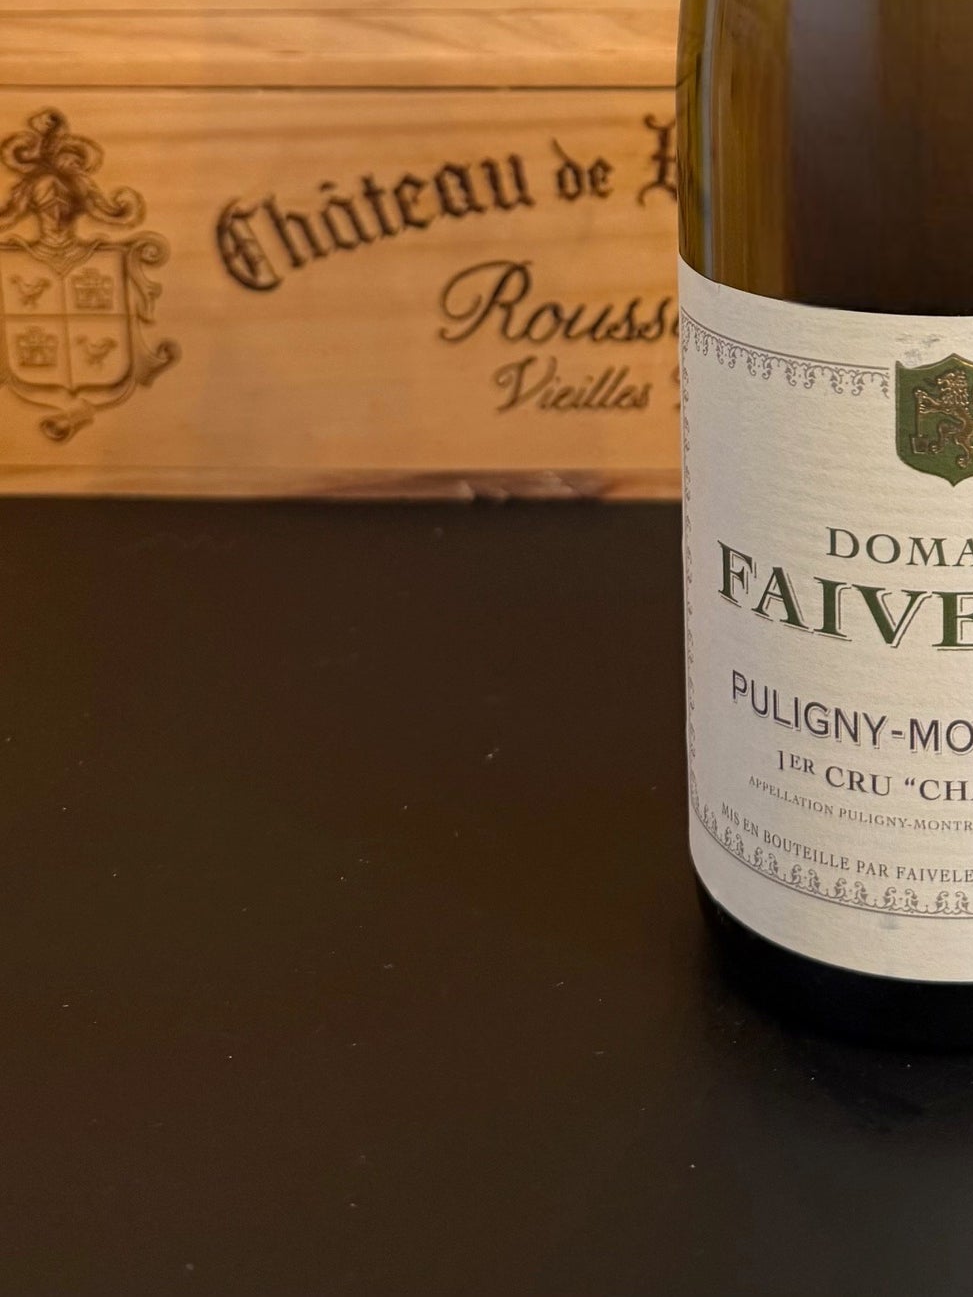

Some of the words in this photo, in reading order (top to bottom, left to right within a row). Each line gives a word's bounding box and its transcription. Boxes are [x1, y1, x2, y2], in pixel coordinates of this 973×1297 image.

[215, 153, 534, 291] Château
[552, 138, 613, 200] de
[438, 258, 679, 342] Rouss
[493, 355, 653, 413] Vieilles
[749, 775, 834, 815] APPELLATION
[825, 765, 892, 796] CRU
[721, 802, 741, 825] MIS
[744, 819, 759, 838] EN
[763, 829, 850, 870] BOUTEILLE
[857, 860, 888, 878] PAR
